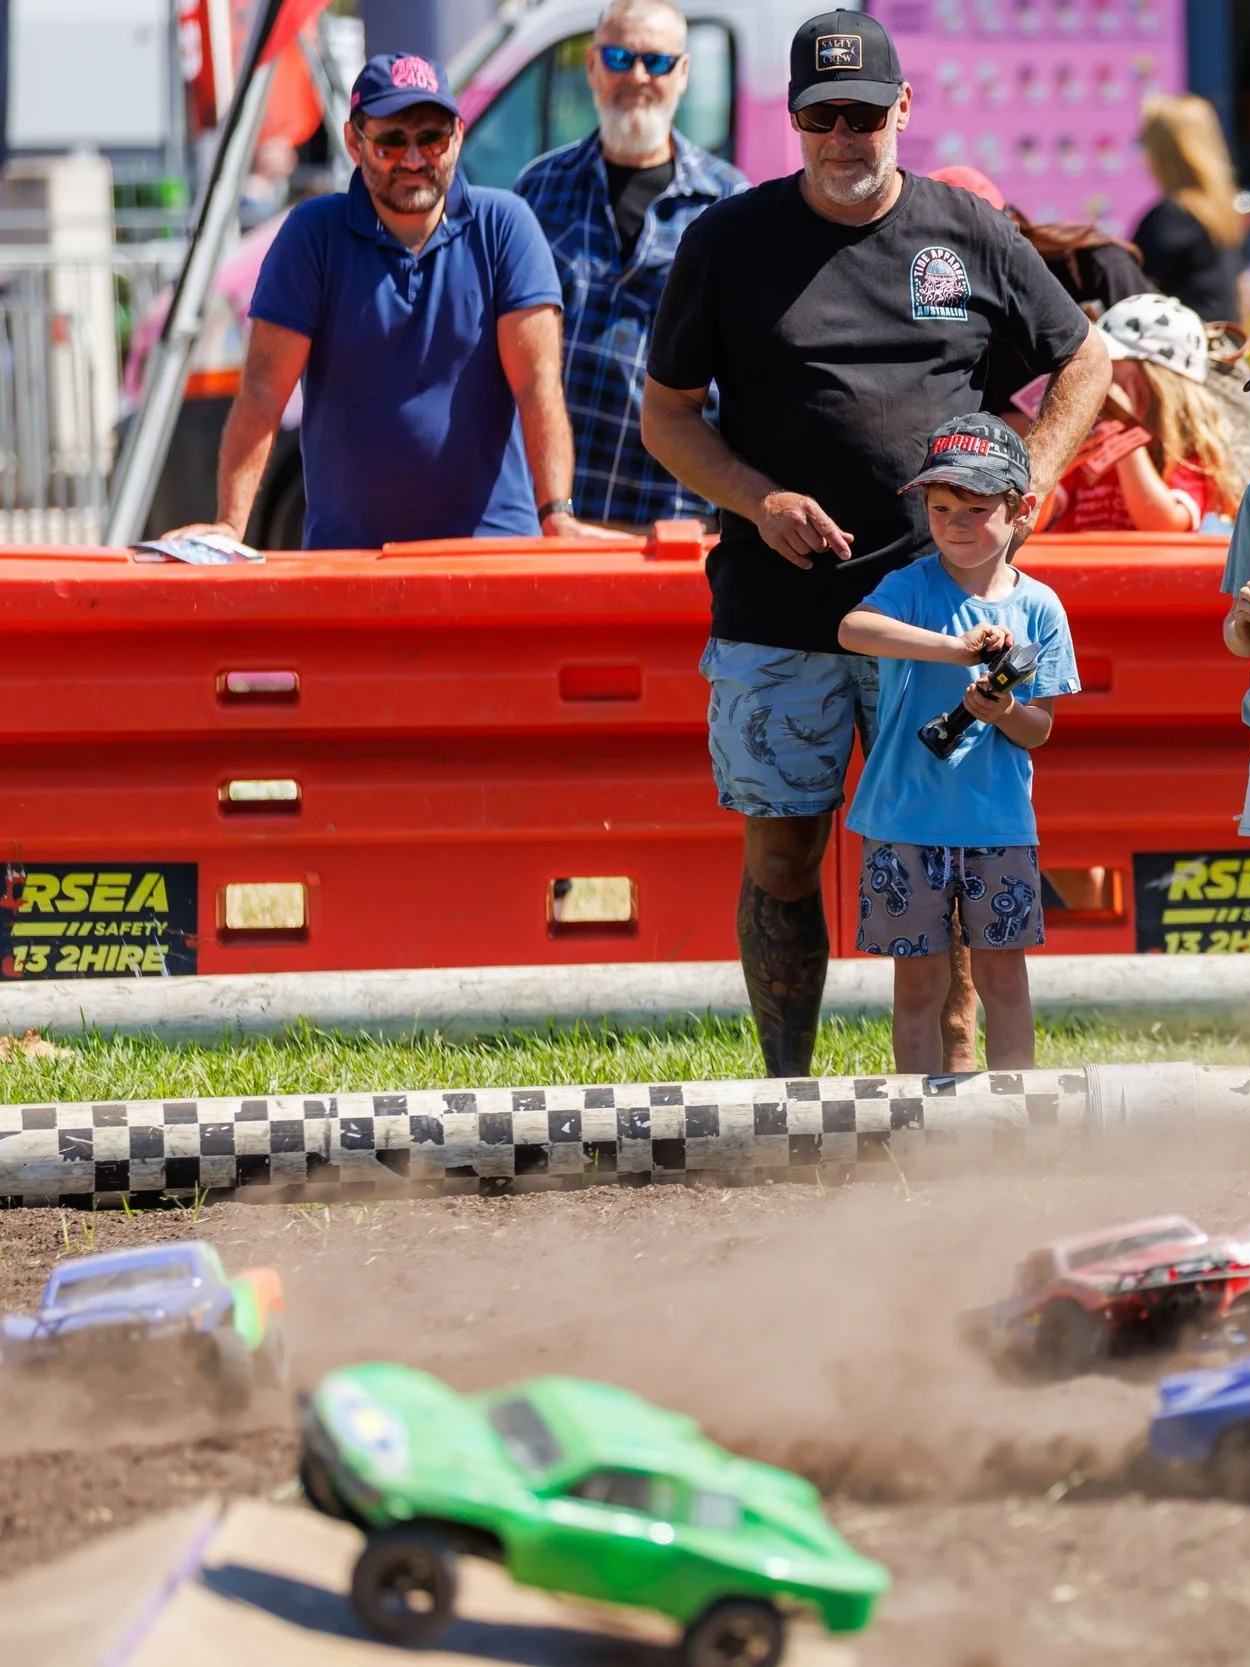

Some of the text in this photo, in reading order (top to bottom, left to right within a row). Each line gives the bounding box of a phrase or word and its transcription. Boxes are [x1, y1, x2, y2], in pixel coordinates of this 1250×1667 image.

[822, 39, 853, 48] SALTY
[823, 54, 853, 64] CREW
[914, 249, 965, 280] TIDE APPAREL
[917, 306, 964, 317] AUSTRALIA
[932, 434, 990, 456] RAPALA
[18, 872, 169, 913] RSEA
[94, 921, 168, 936] SAFETY
[1164, 931, 1203, 954] 13
[13, 945, 169, 972] 13 2HIRE
